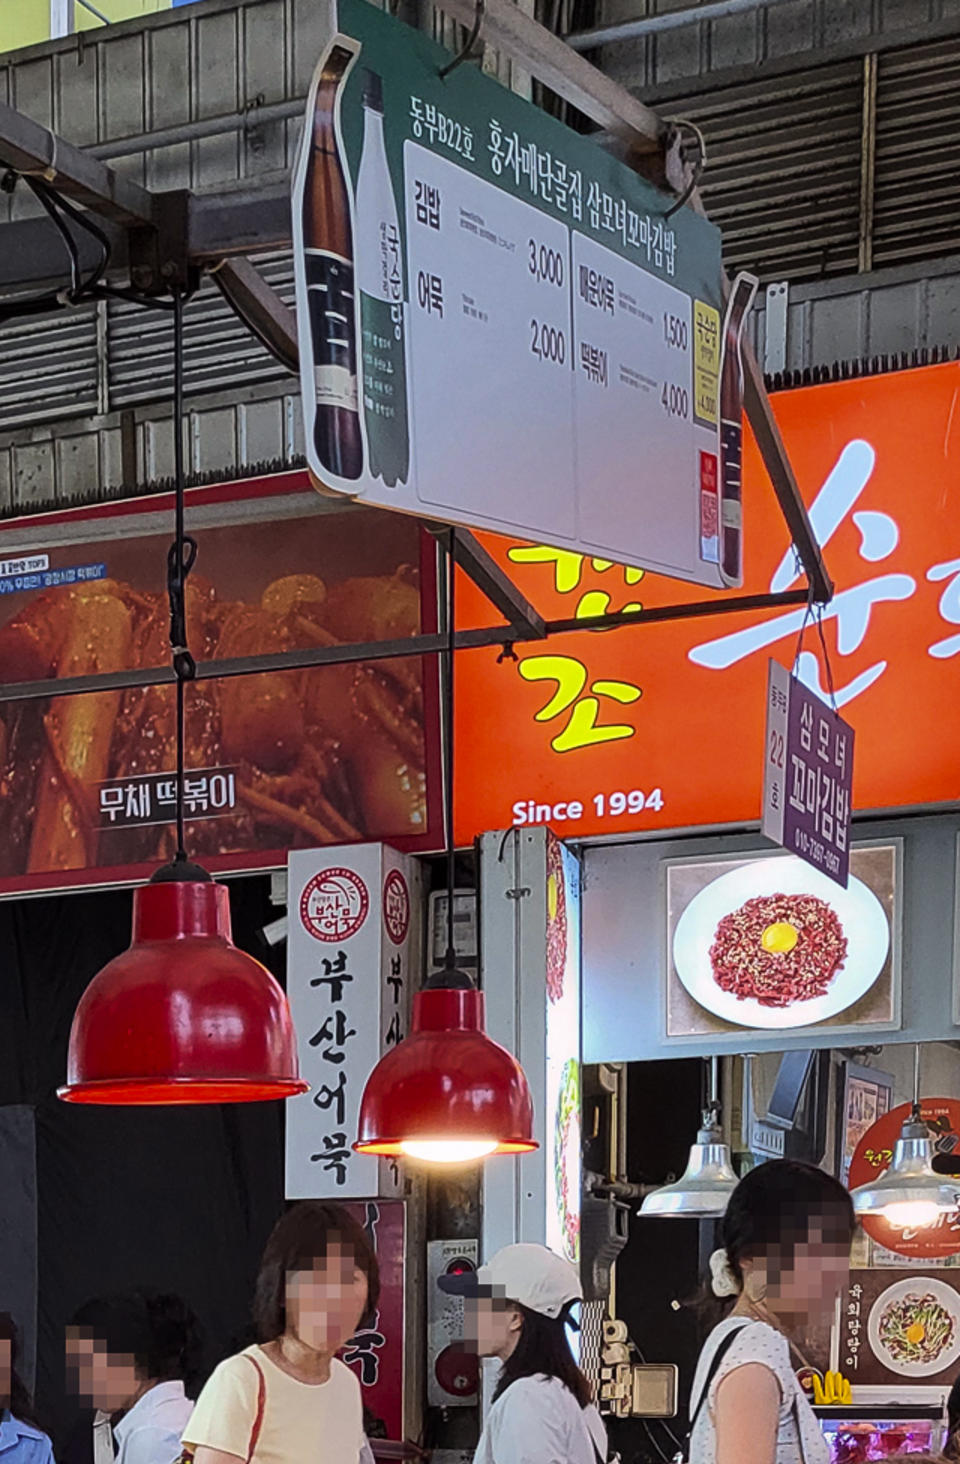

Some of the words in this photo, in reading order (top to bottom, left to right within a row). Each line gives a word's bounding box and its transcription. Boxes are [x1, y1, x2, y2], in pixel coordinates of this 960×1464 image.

[409, 95, 476, 162] 동부B22호
[487, 119, 584, 223] 홍자매단골집
[586, 181, 678, 277] 삼모녀꼬마김밥
[414, 180, 441, 231] 김밥
[528, 238, 564, 288] 3,000
[417, 270, 444, 319] 어묵
[530, 319, 566, 365] 2,000
[663, 312, 689, 351] 1,500
[581, 342, 608, 389] 떡볶이
[661, 381, 689, 420] 4,000
[770, 729, 785, 769] 22
[100, 783, 151, 822] 무채
[156, 773, 236, 813] 떡볶이
[512, 800, 584, 826] Since
[593, 787, 665, 818] 1994
[789, 753, 849, 853] 꼬마김밥
[308, 950, 357, 1186] 부산어묵
